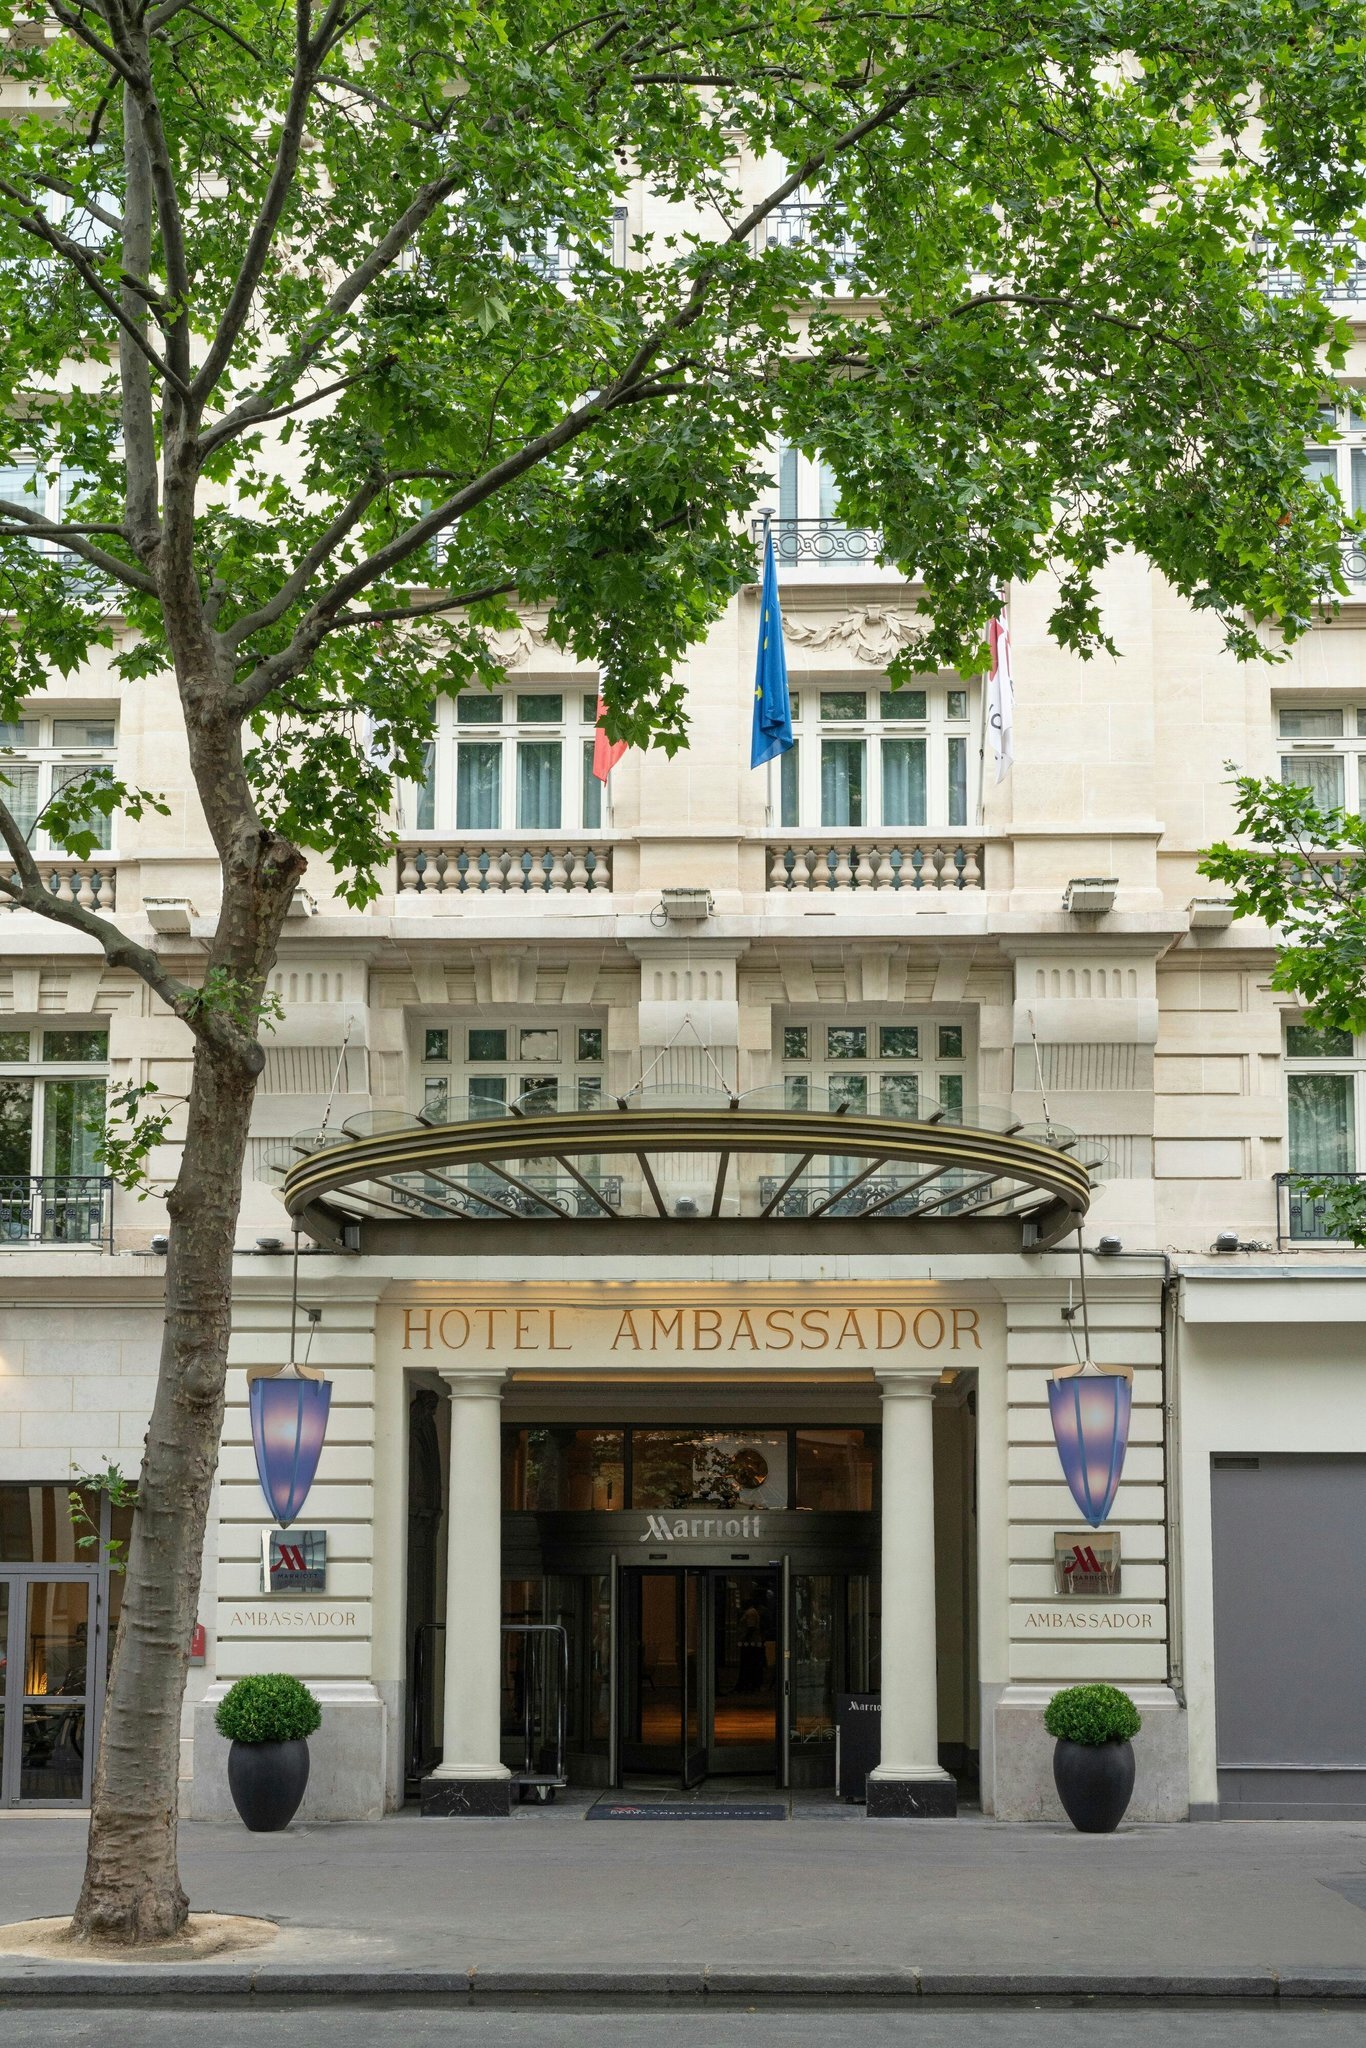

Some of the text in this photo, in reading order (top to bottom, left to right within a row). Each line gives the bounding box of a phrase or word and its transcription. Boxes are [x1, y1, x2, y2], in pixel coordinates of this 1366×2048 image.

[402, 1308, 983, 1351] HOTEL AMBASSADOR
[638, 1514, 762, 1542] Marriott
[230, 1611, 356, 1626] AMBASSADOR
[1024, 1613, 1153, 1628] AMBASSADOR
[848, 1701, 882, 1712] Marrio
